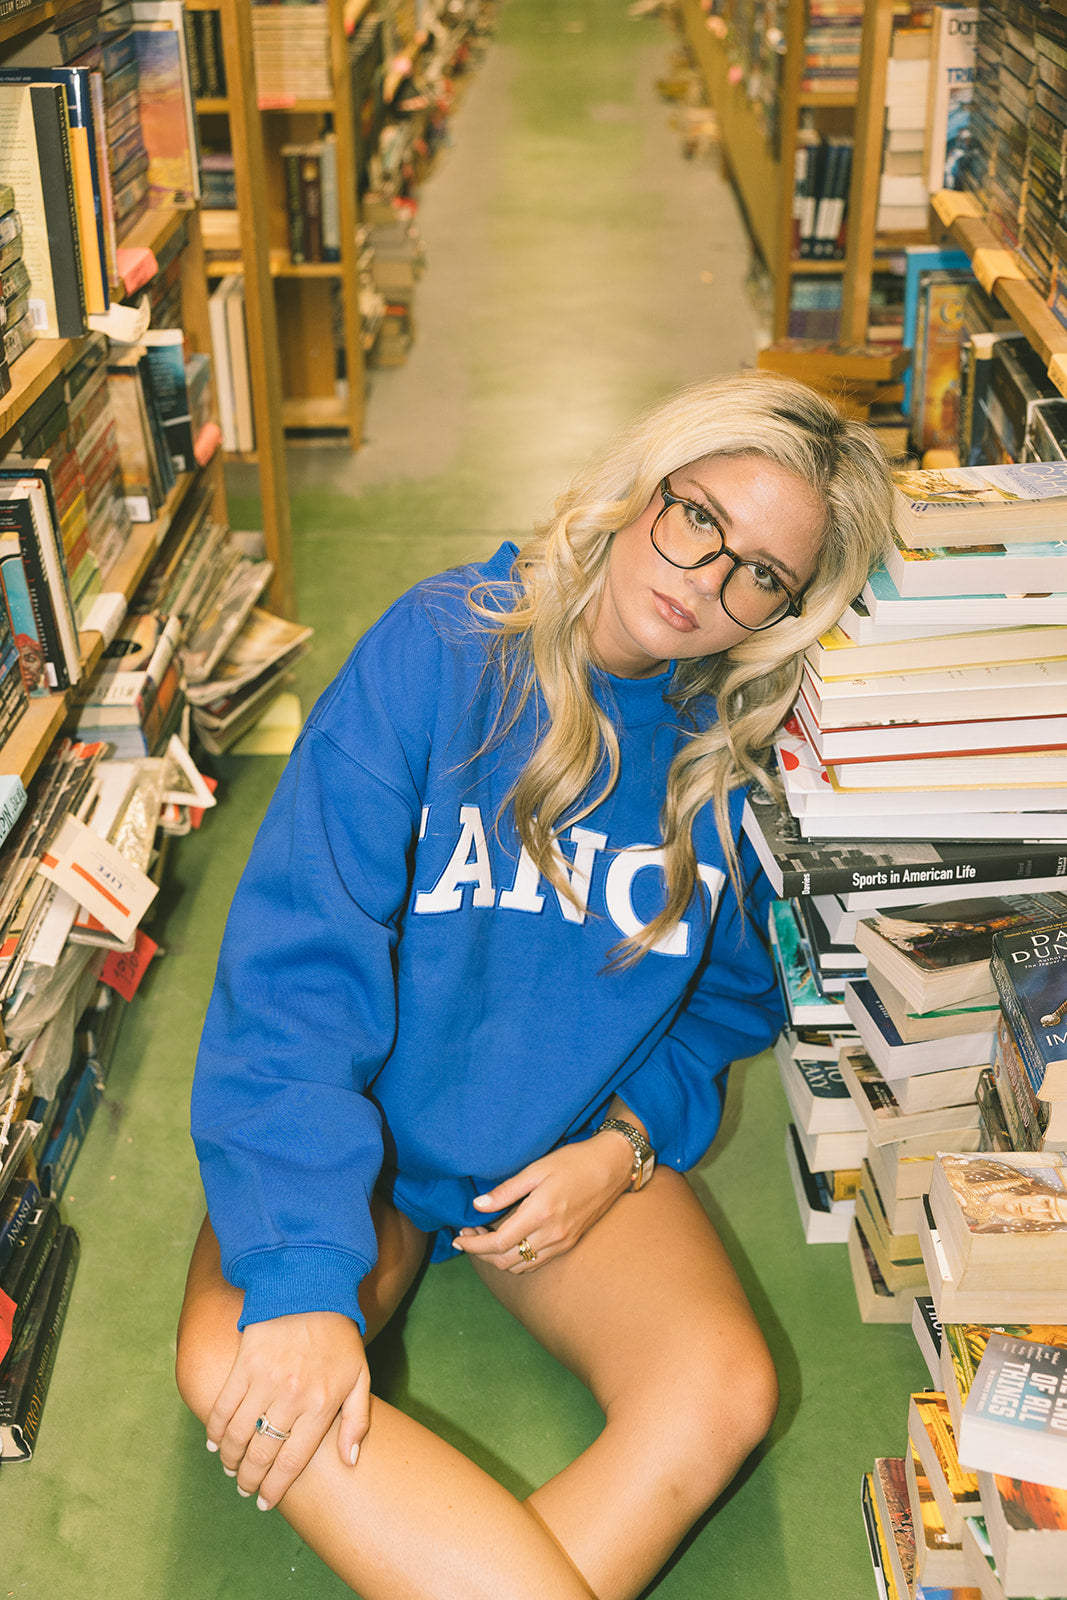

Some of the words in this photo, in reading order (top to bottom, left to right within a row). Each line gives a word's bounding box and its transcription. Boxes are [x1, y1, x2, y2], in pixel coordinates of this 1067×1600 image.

[802, 873, 811, 895] Davies
[852, 871, 888, 889] Sports
[889, 869, 900, 884] in
[902, 867, 953, 883] American
[955, 865, 977, 880] Life
[6, 1199, 31, 1247] ANANSI
[987, 1361, 1031, 1419] THINGS
[1029, 1372, 1059, 1396] OF
[23, 1386, 43, 1440] TROY
[1018, 1394, 1052, 1422] ALL
